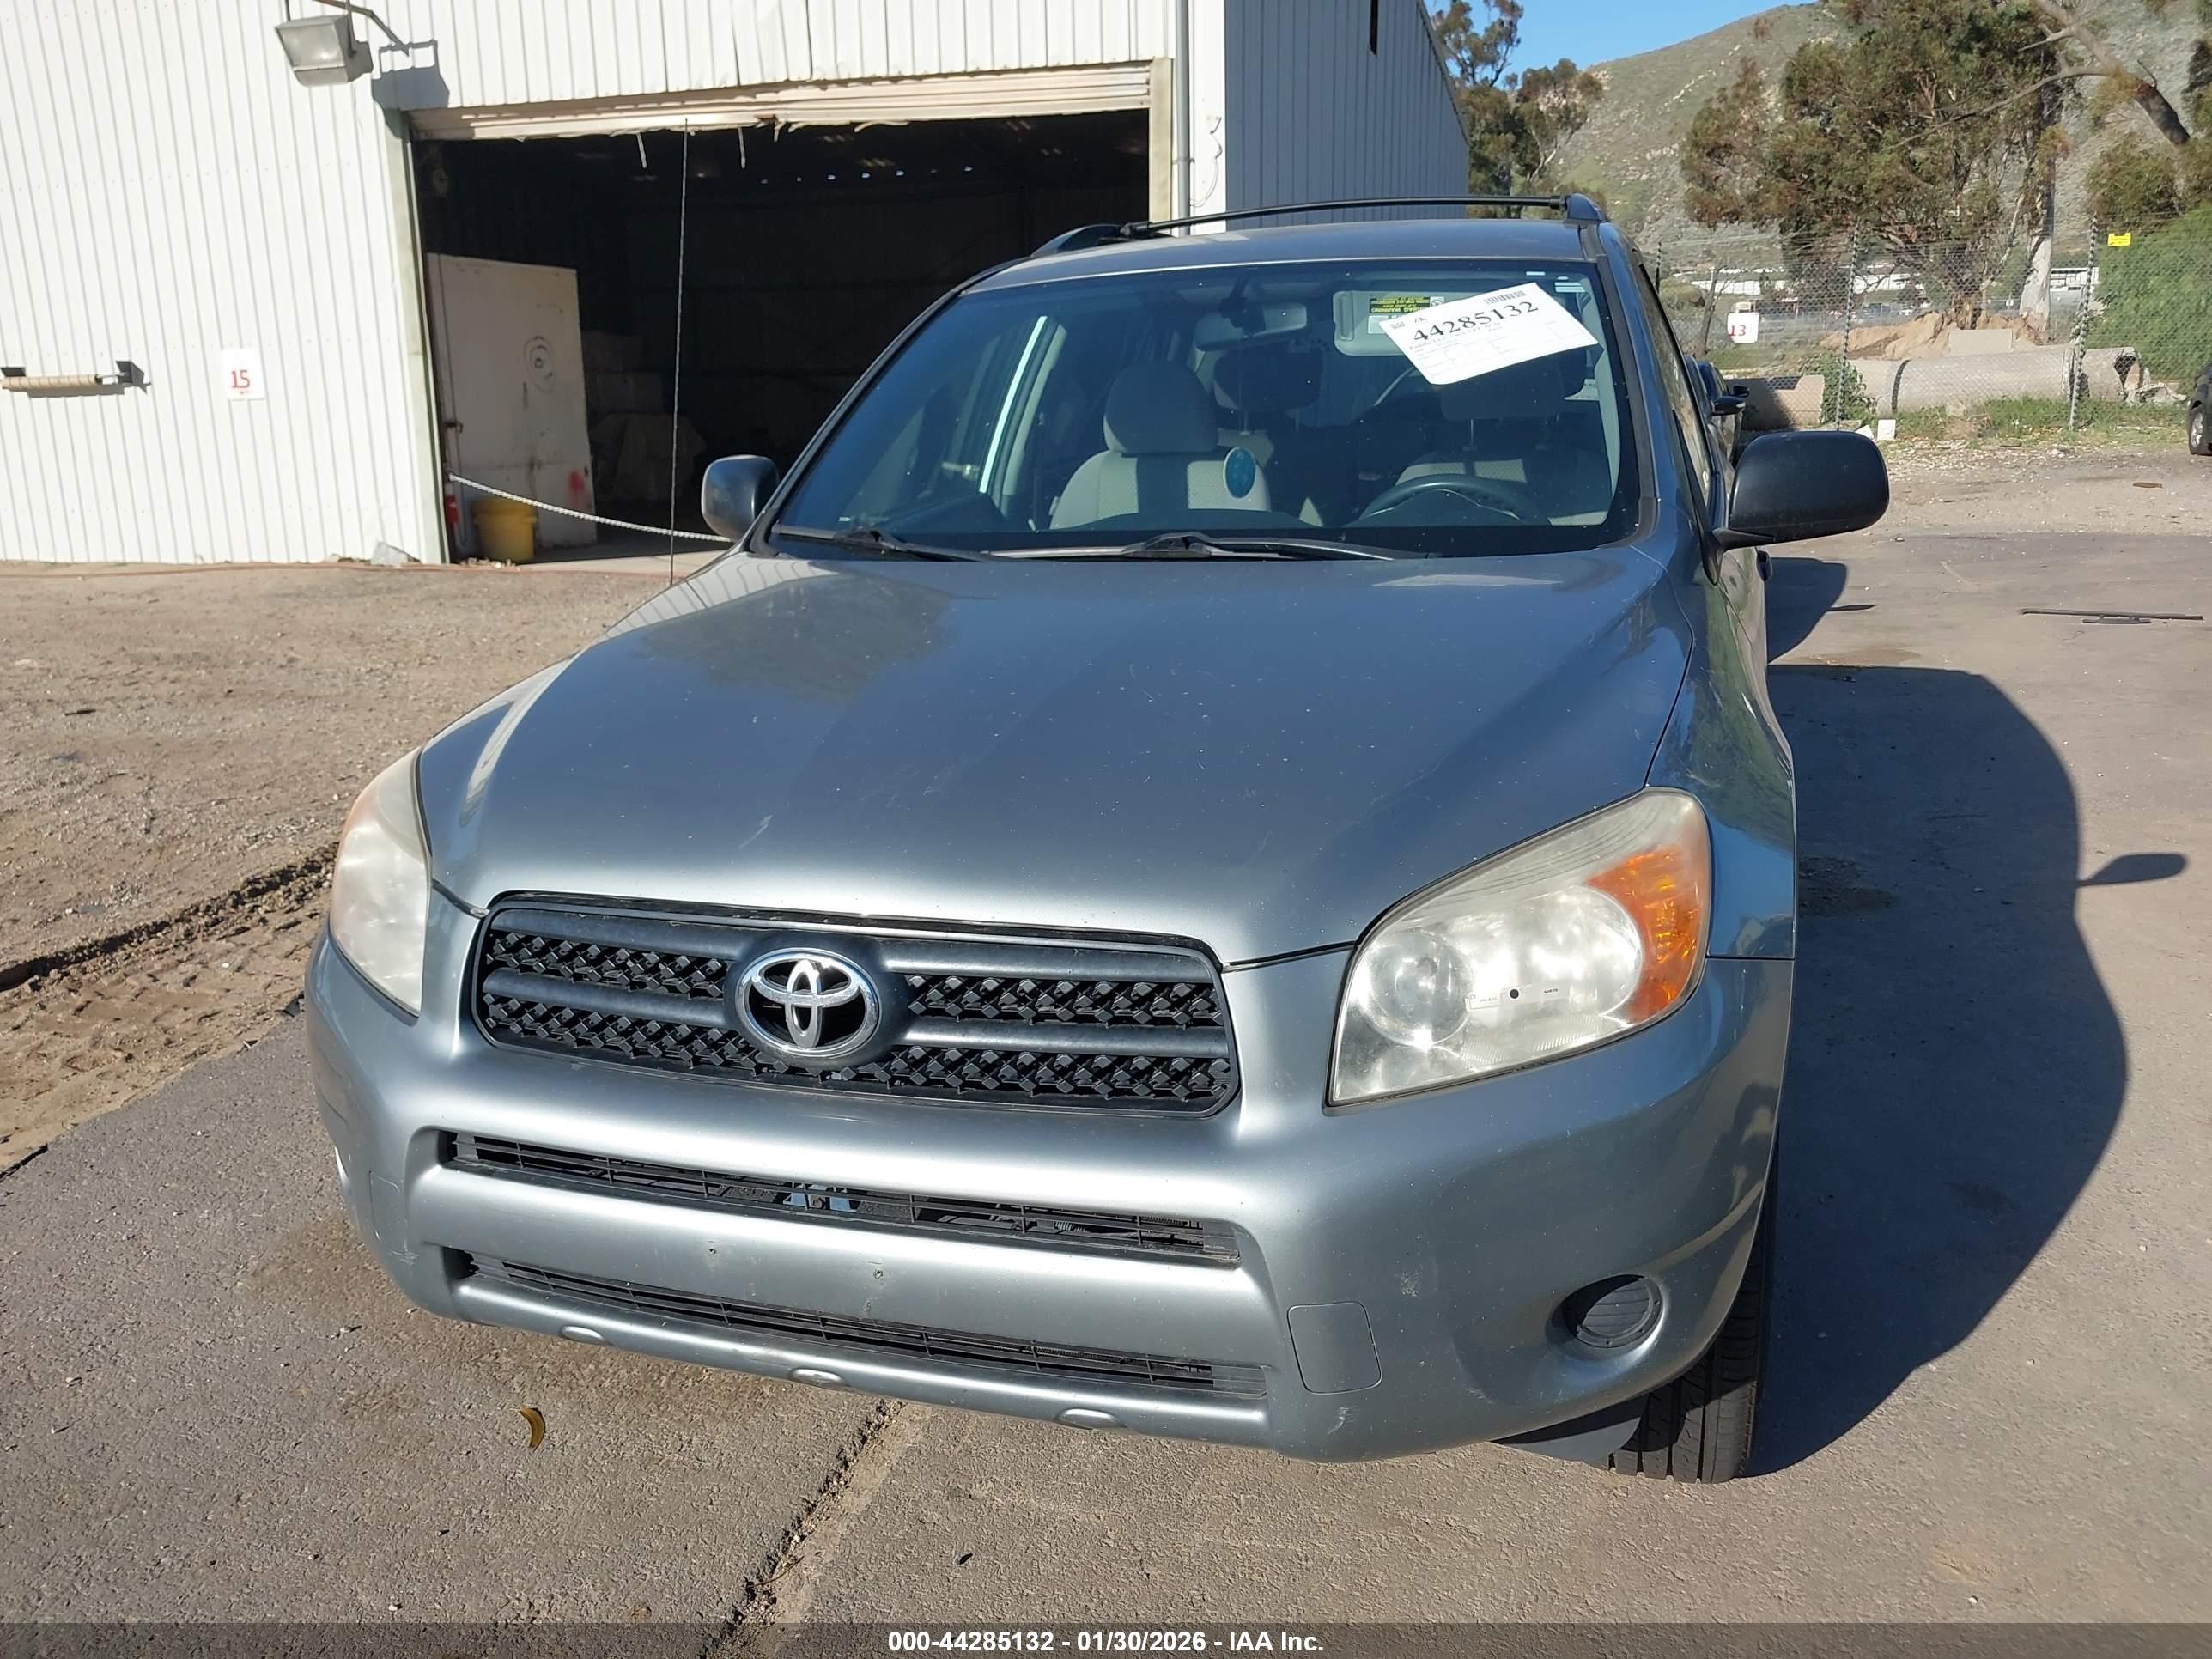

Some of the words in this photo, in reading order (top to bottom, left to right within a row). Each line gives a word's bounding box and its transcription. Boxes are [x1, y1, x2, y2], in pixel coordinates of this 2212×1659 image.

[1413, 301, 1540, 340] 44285132
[1729, 325, 1746, 337] 13
[231, 369, 250, 388] 15
